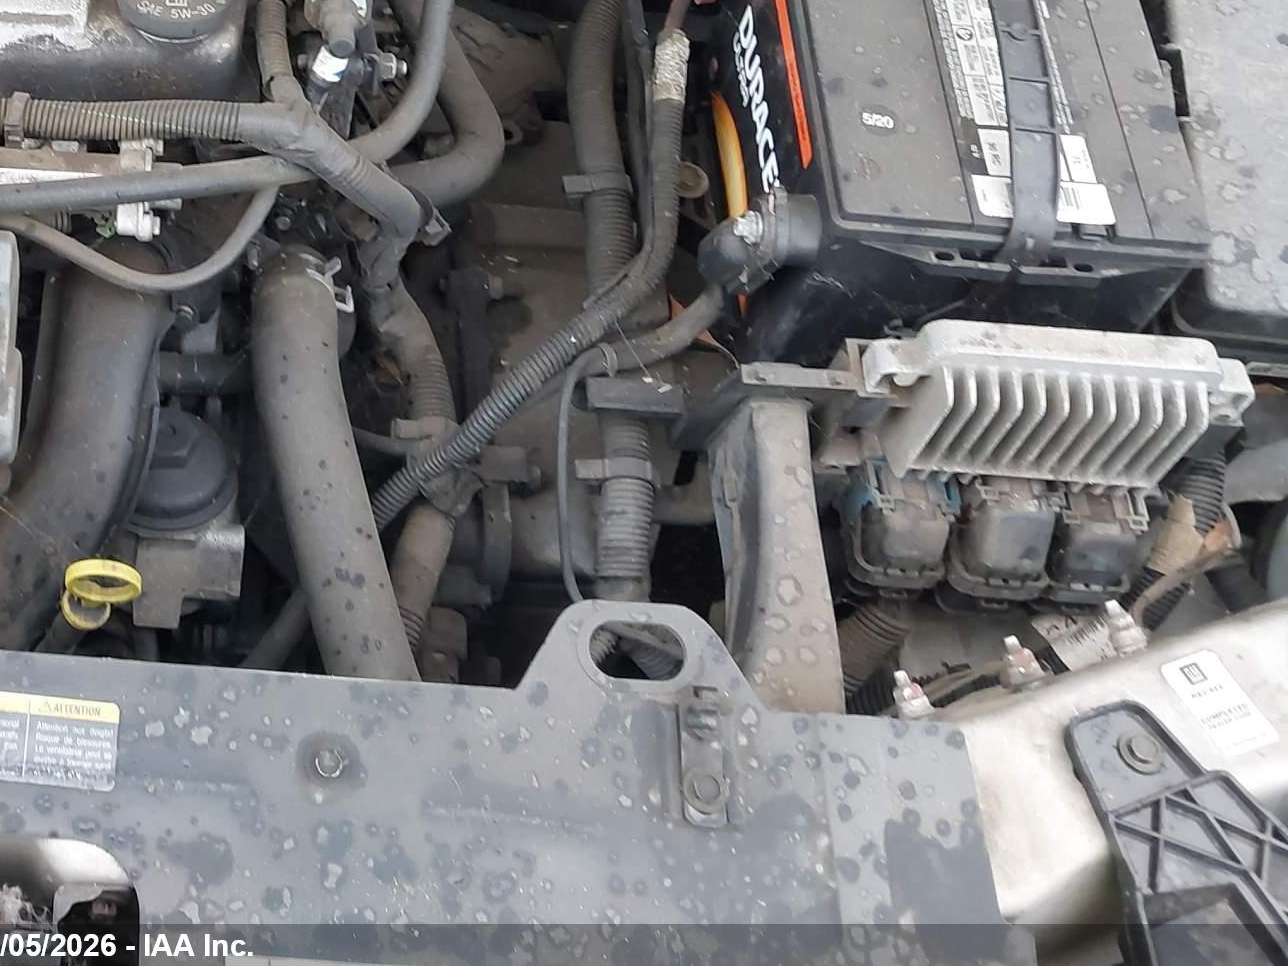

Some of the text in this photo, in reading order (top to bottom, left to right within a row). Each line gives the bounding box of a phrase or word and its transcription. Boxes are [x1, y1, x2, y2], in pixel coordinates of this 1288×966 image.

[136, 0, 216, 19] SAE 5W-30
[738, 4, 781, 194] DURACE
[52, 703, 101, 716] ATTENTION
